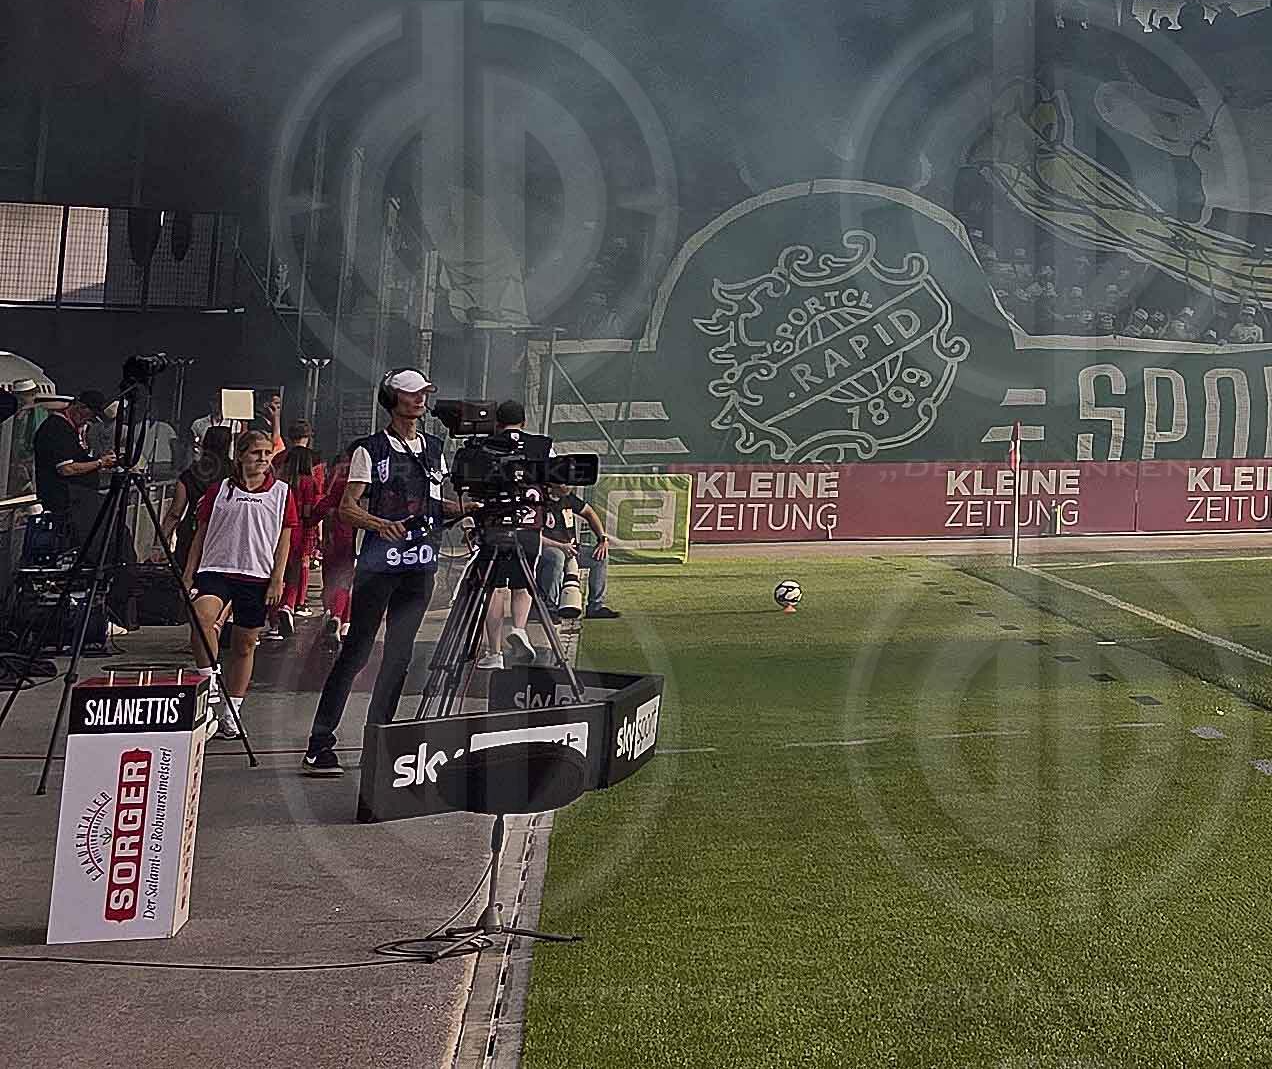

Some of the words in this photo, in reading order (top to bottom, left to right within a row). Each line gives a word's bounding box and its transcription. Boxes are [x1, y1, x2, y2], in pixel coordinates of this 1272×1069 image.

[789, 307, 924, 392] RAPID
[846, 366, 933, 431] 1899
[697, 471, 839, 498] KLEINE
[945, 470, 1081, 495] KLEINE
[693, 503, 838, 531] ZEITUNG
[944, 500, 1080, 528] ZEITUNG
[85, 697, 179, 726] SALANETTIS
[109, 760, 149, 910] SORGER
[143, 898, 156, 920] Der
